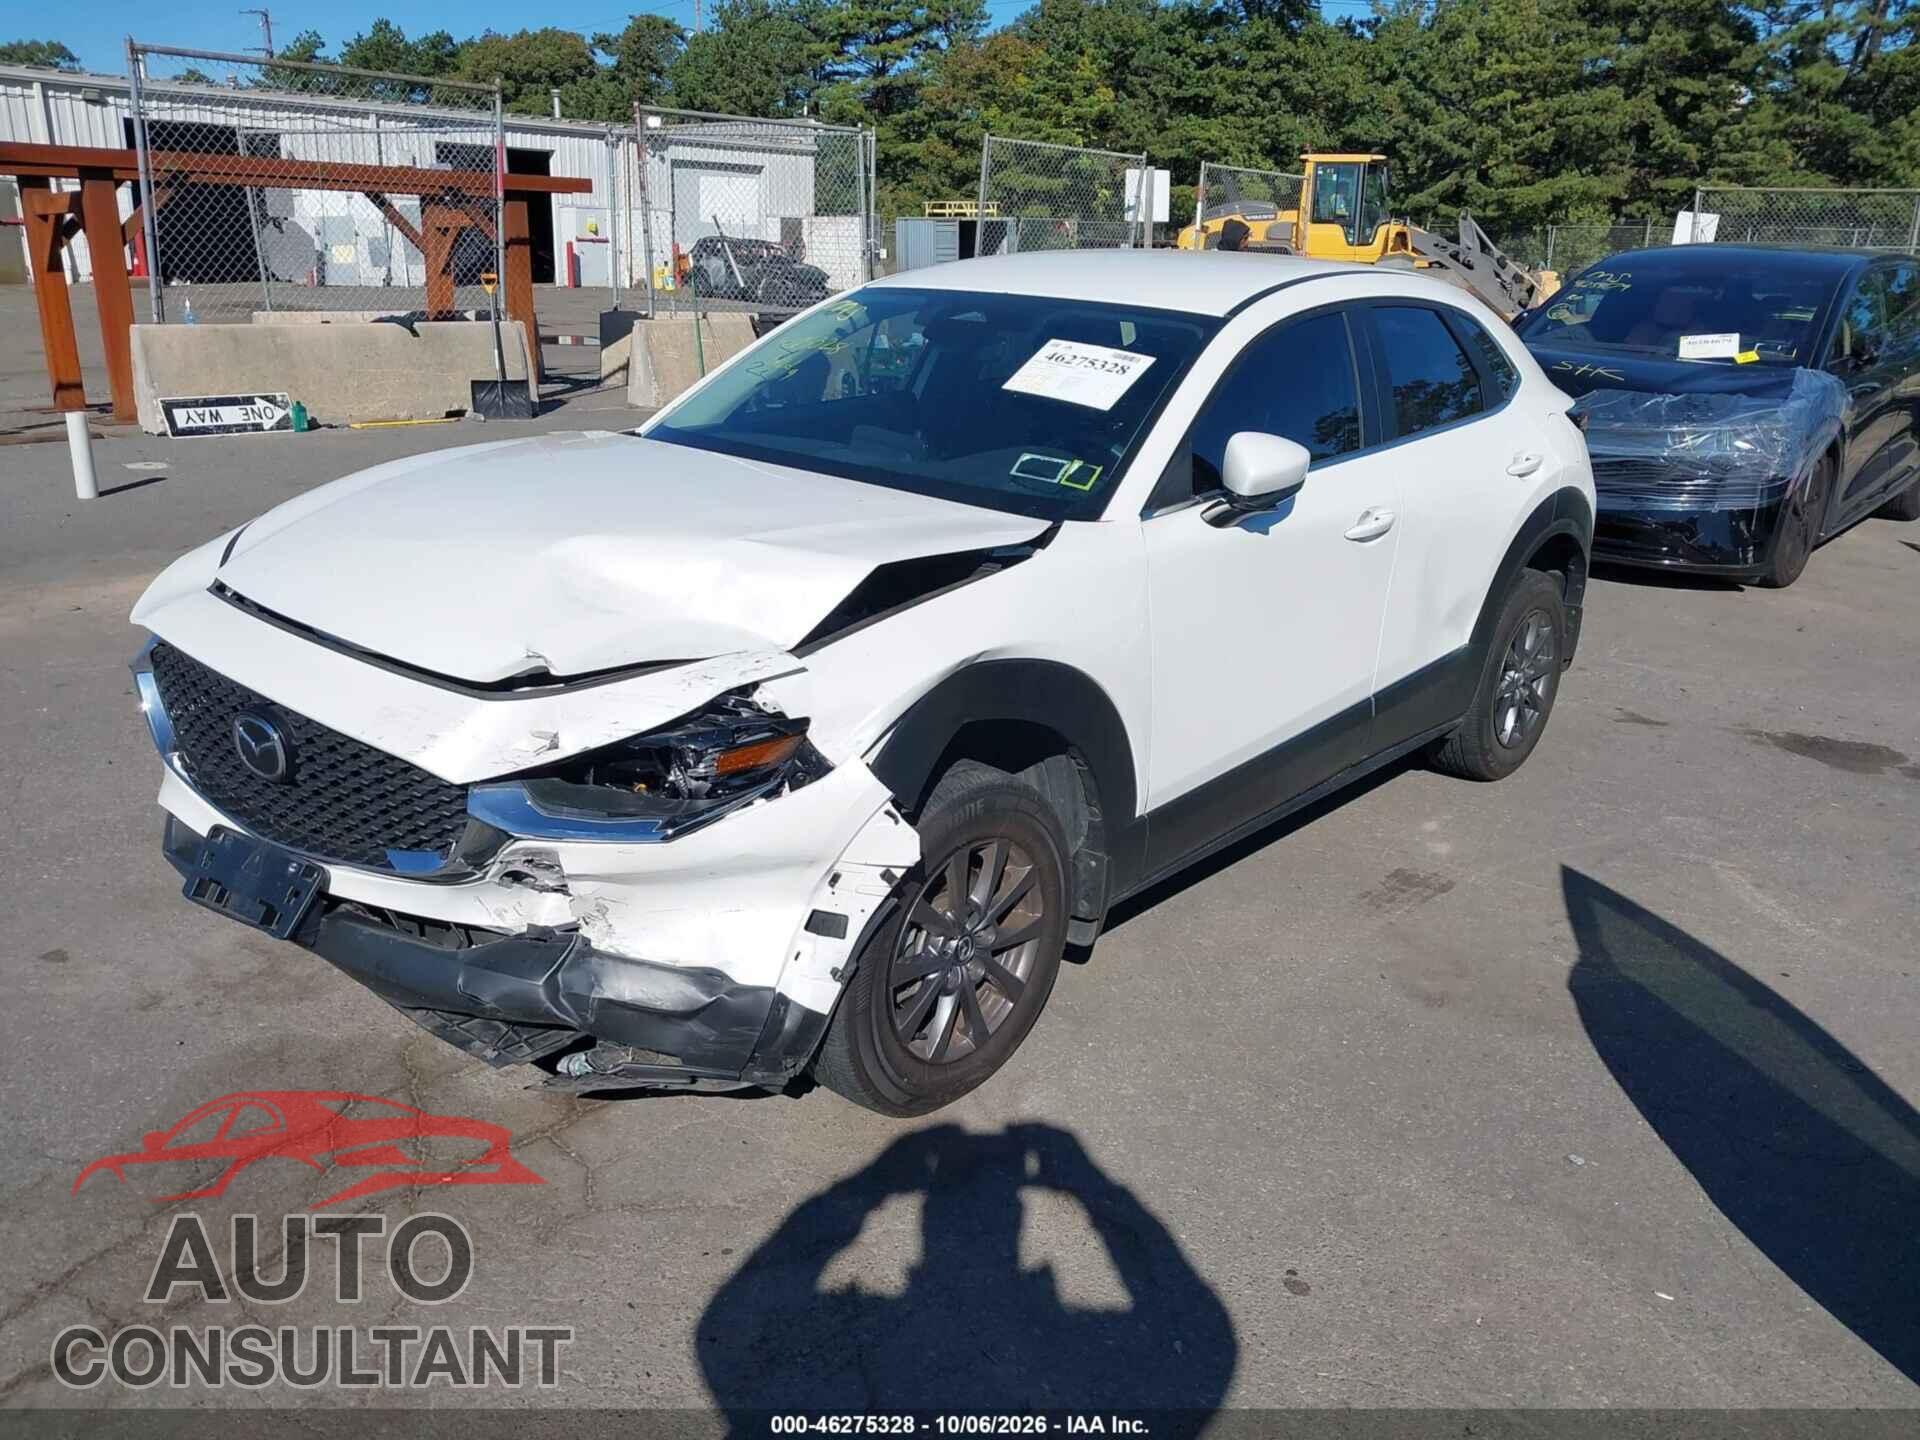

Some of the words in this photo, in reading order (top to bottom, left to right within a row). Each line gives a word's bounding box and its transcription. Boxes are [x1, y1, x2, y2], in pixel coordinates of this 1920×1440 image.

[1045, 351, 1131, 376] 46275328
[185, 408, 224, 424] WAY
[238, 406, 275, 421] ONE
